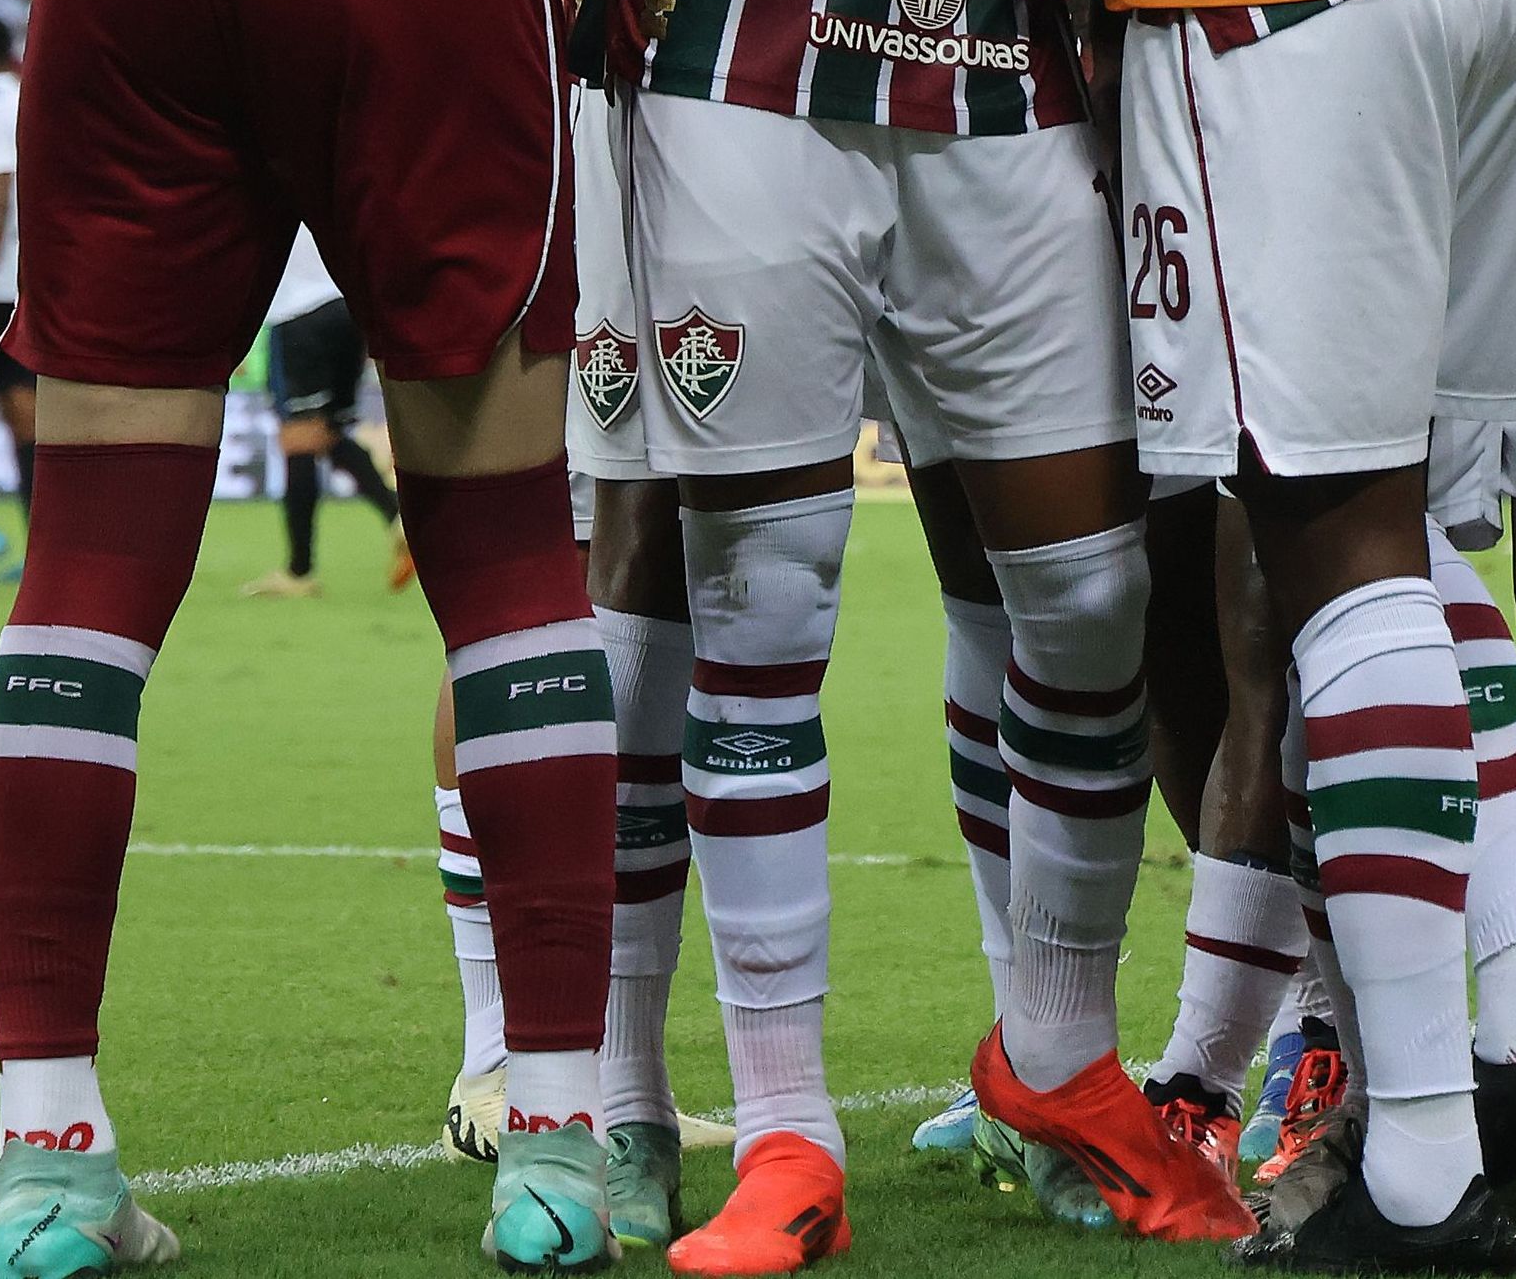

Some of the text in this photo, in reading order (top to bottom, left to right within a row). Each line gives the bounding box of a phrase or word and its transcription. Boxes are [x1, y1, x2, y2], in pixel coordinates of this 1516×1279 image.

[1131, 203, 1189, 321] 26
[6, 674, 84, 699] FFC
[507, 674, 587, 701] FFC
[1467, 683, 1506, 703] FC
[1441, 795, 1479, 817] FF
